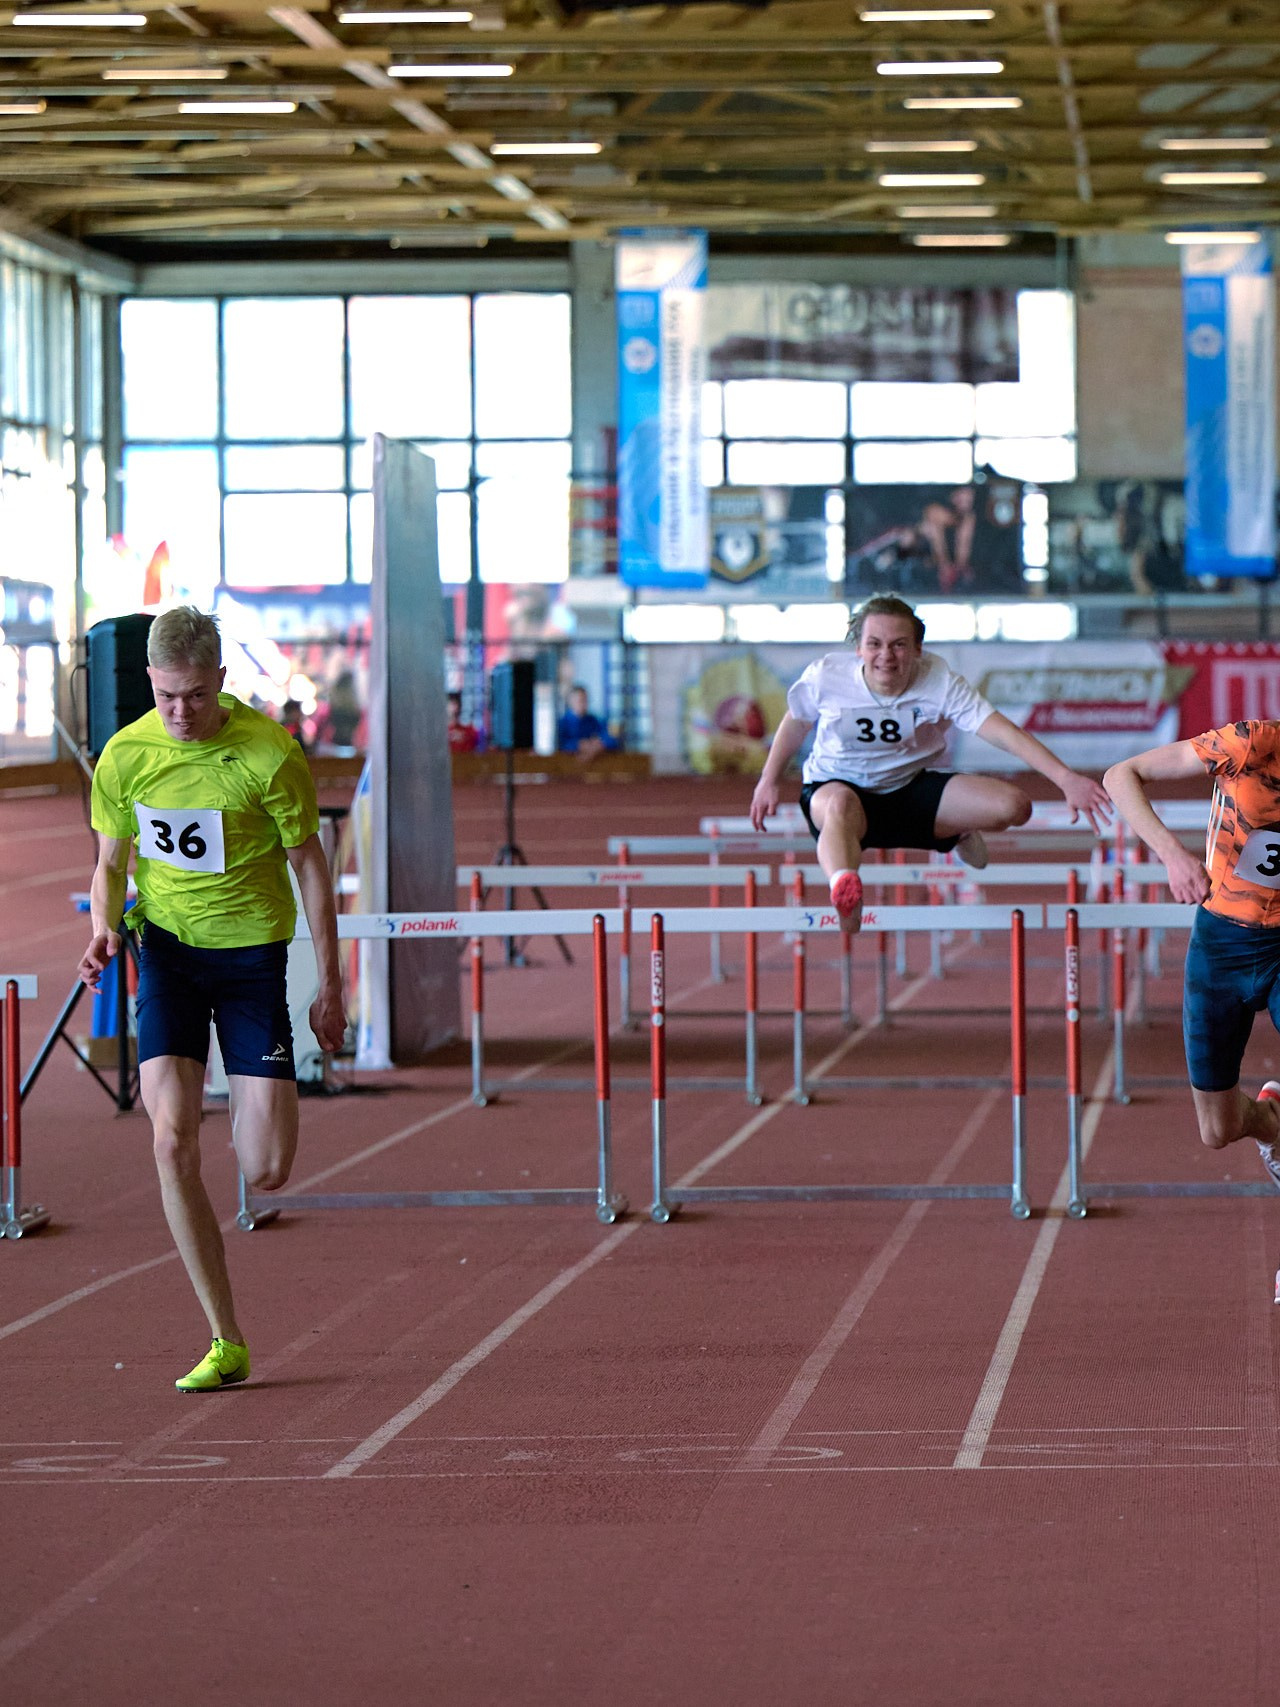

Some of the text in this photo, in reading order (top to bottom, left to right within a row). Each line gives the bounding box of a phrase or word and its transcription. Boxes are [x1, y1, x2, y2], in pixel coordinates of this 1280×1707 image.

[856, 718, 902, 743] 38
[150, 819, 207, 860] 36
[401, 918, 458, 934] polanik
